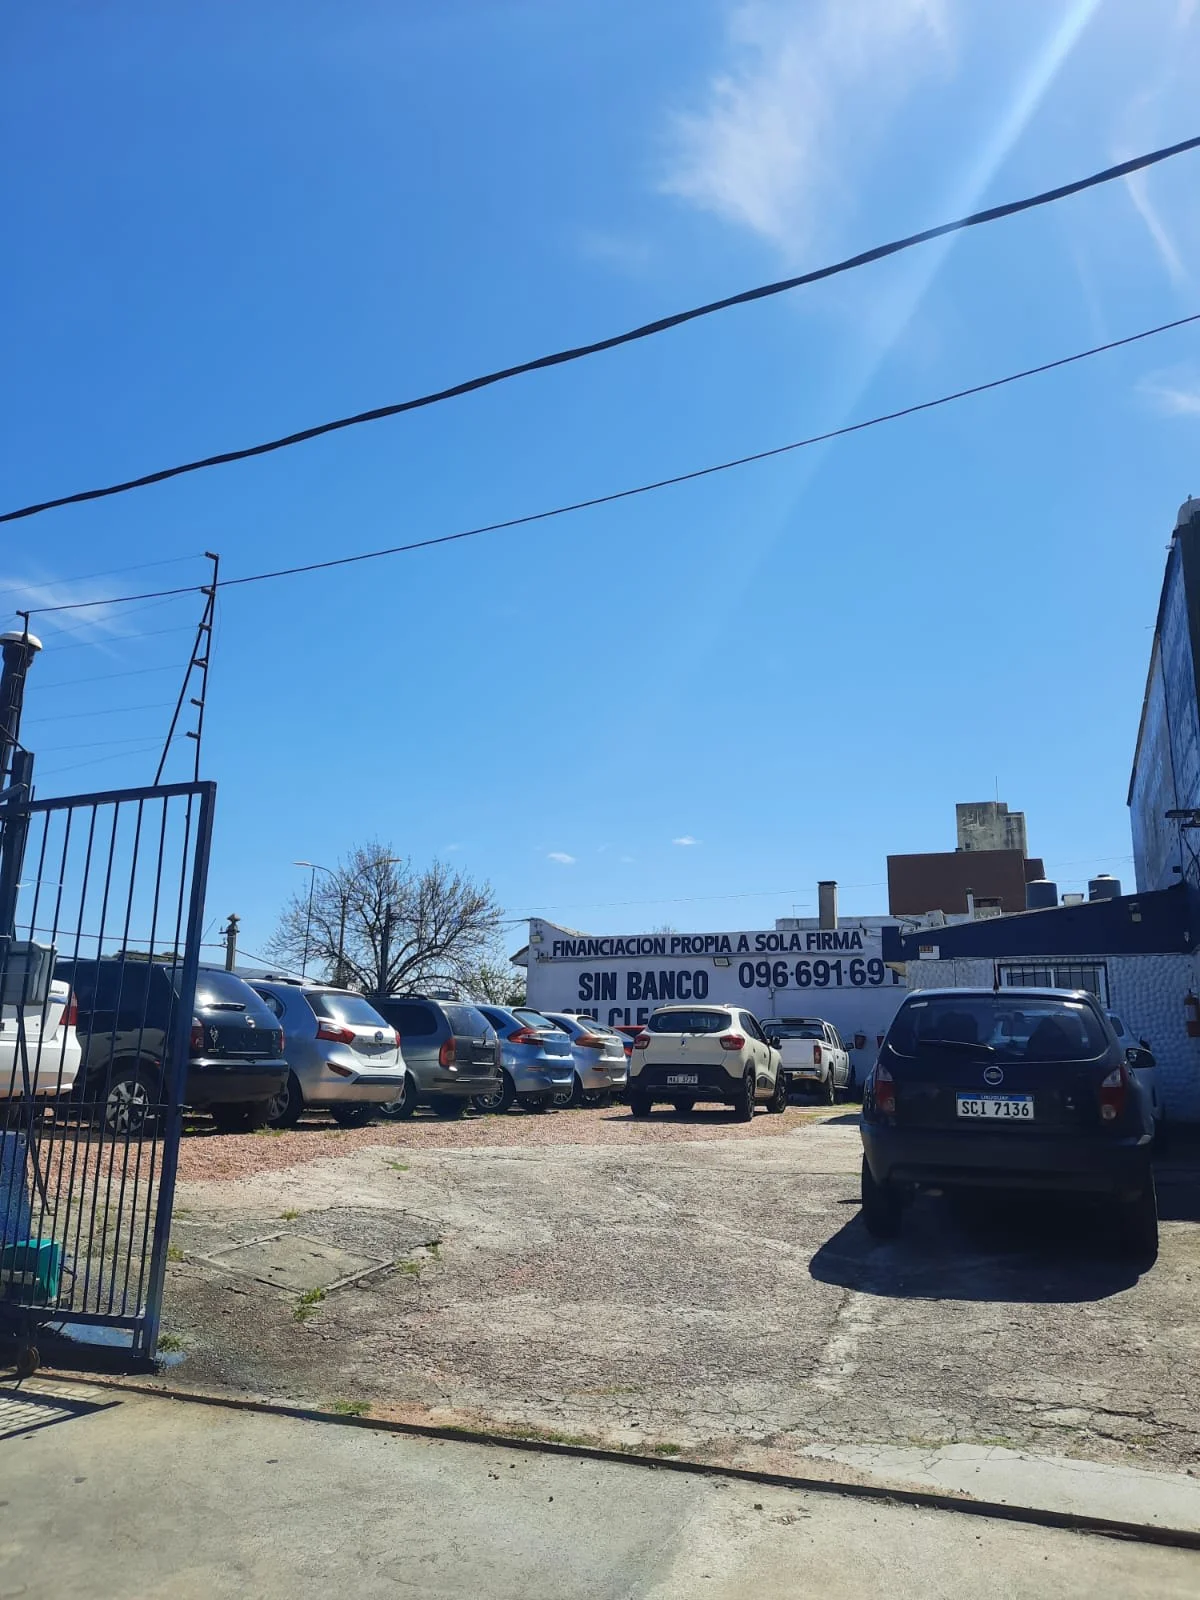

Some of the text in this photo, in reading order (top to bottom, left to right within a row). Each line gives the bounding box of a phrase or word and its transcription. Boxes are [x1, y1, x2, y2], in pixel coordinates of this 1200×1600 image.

[552, 931, 863, 957] FINANCIACION PROPIA A SOLA FIRMA
[578, 970, 709, 1001] SIN BANCO
[962, 1101, 1029, 1117] SCI 7136
